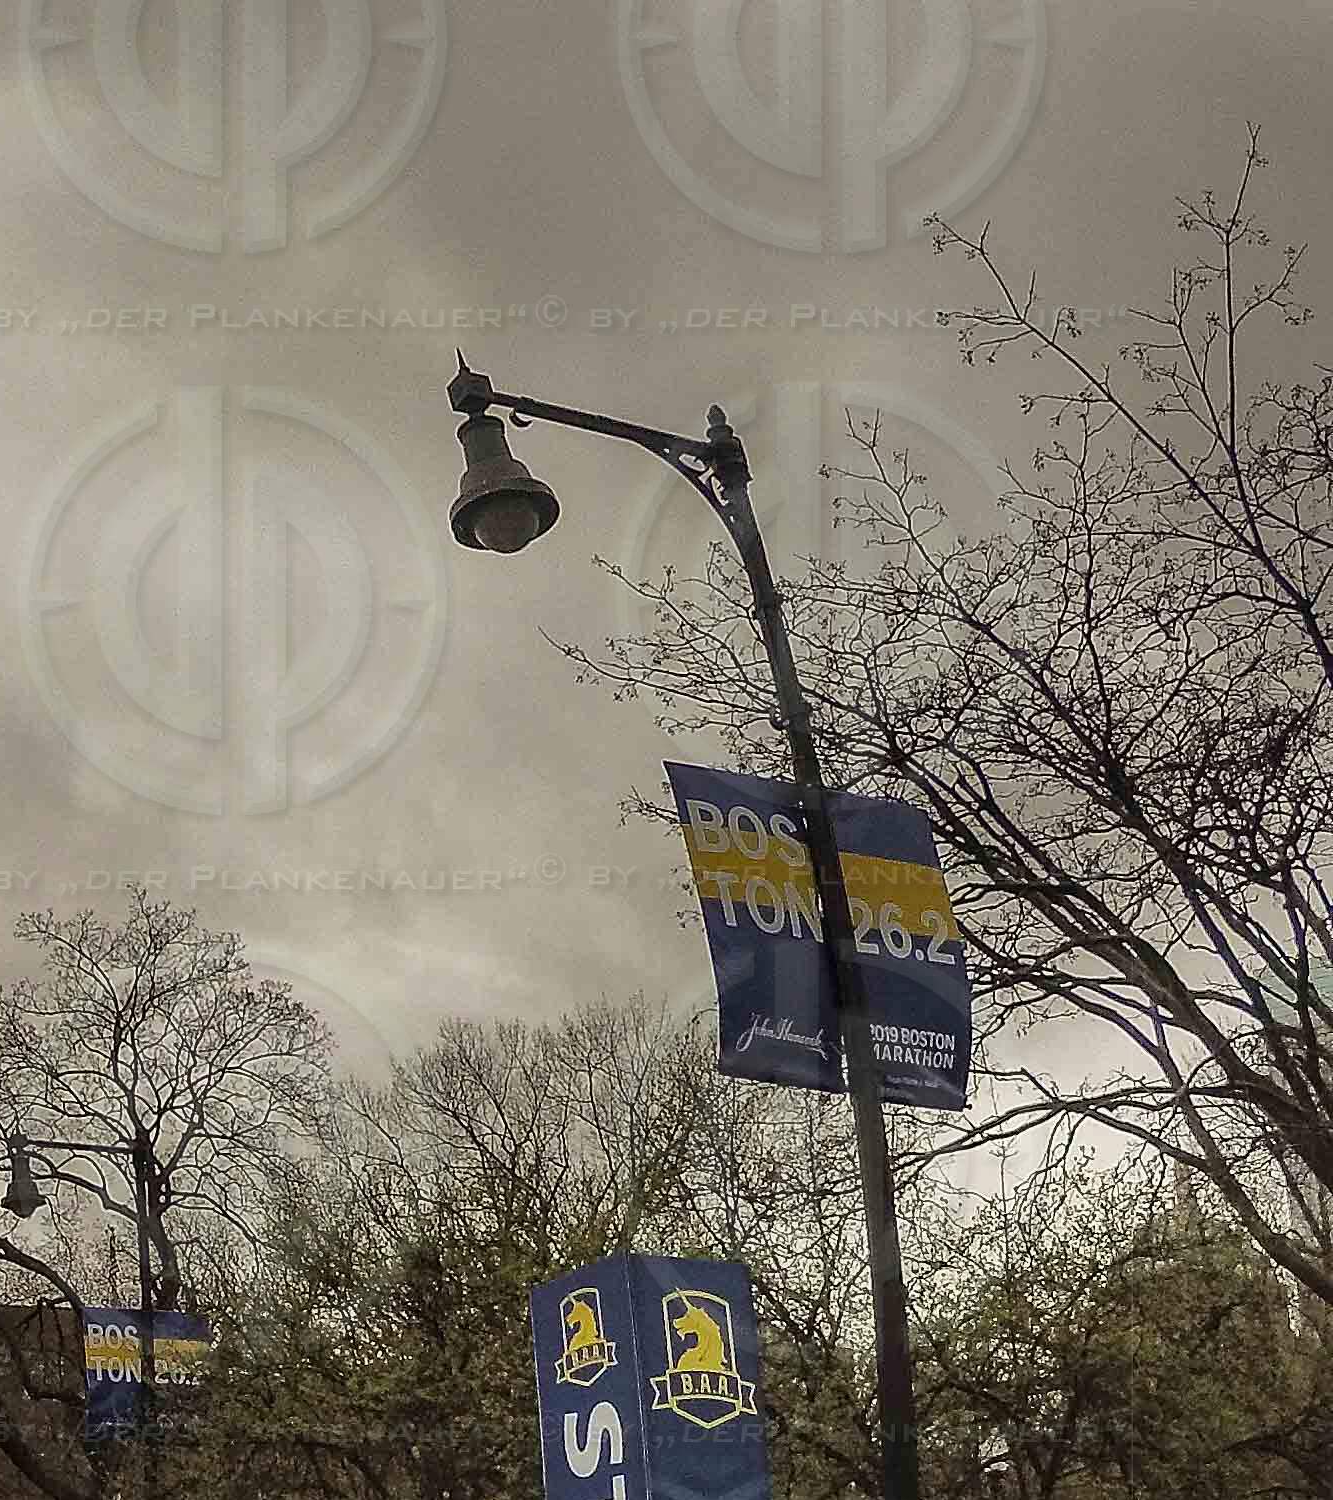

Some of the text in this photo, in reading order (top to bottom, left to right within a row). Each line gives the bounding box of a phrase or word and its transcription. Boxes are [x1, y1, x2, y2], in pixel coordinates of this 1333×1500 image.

[685, 799, 806, 867] BOS
[703, 871, 825, 943] TON
[849, 898, 956, 965] 26.2
[900, 1027, 955, 1051] BOSTON
[87, 1323, 141, 1352] BOS
[89, 1357, 142, 1383] TON
[681, 1373, 734, 1397] B.A.A.
